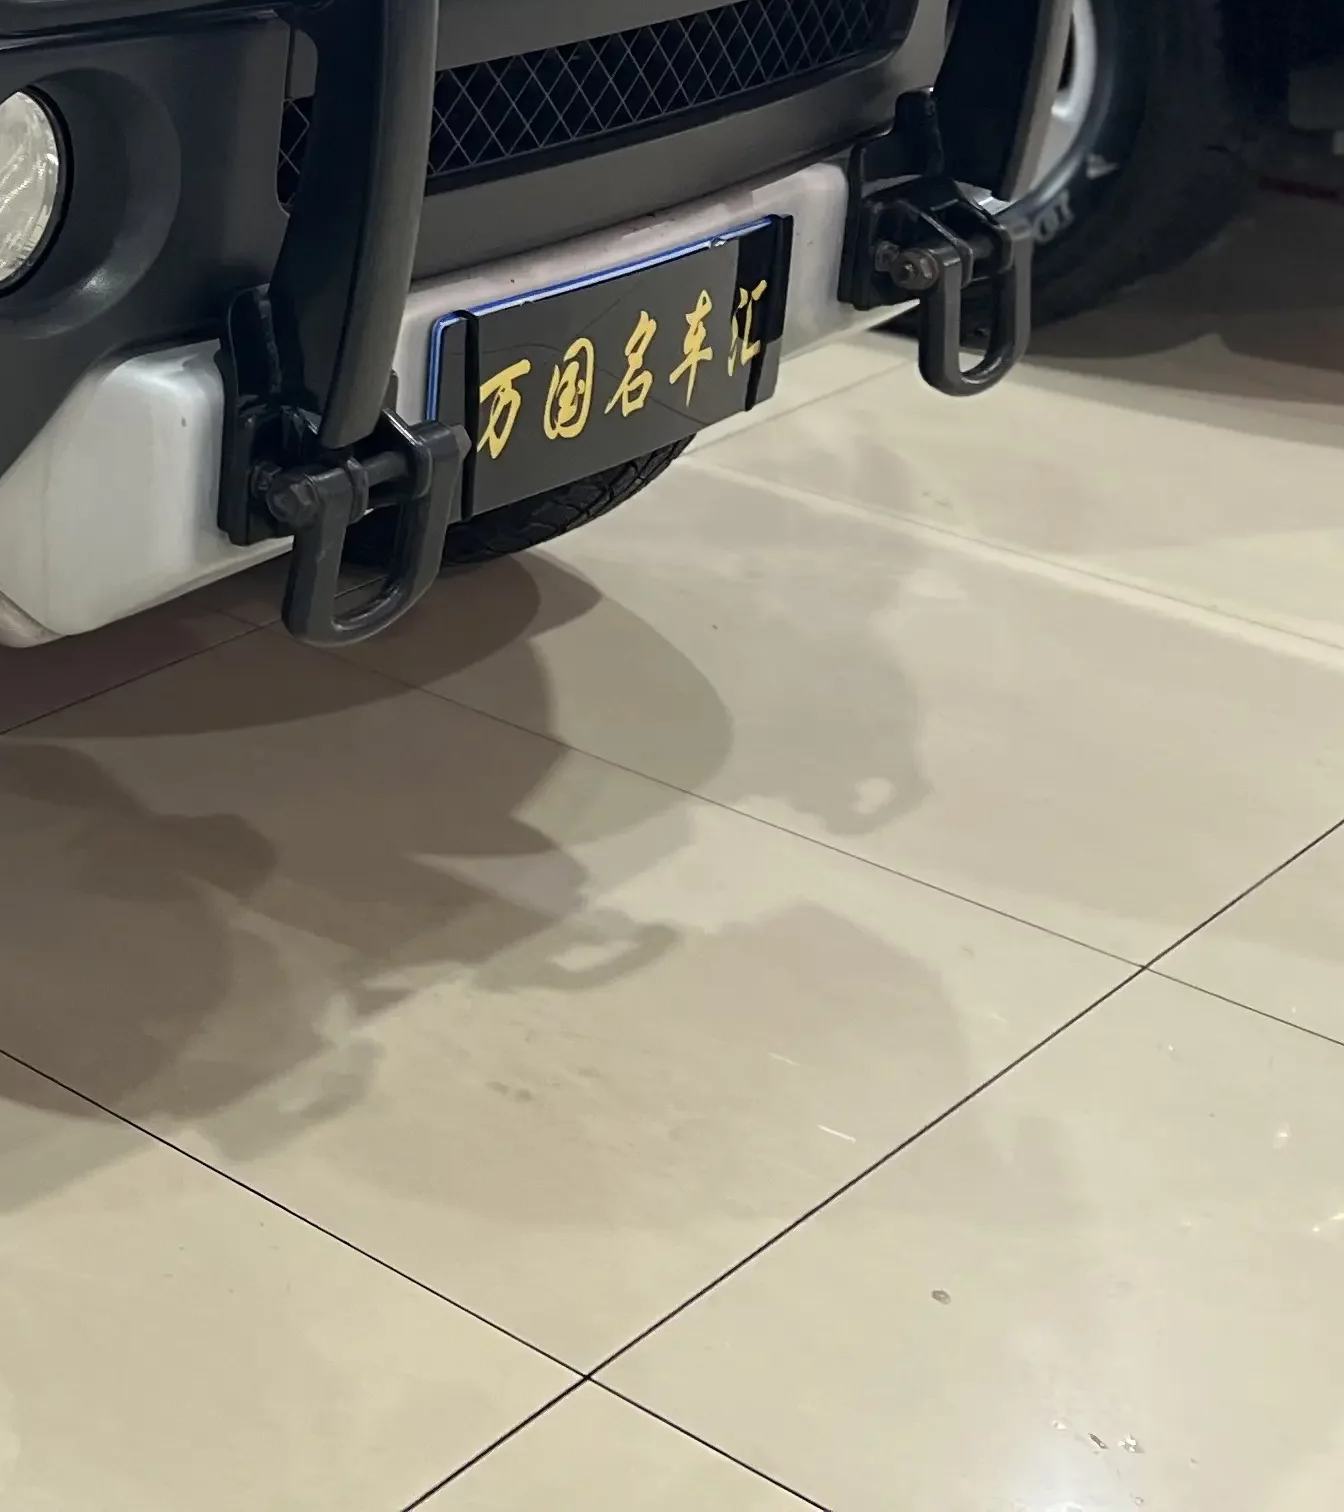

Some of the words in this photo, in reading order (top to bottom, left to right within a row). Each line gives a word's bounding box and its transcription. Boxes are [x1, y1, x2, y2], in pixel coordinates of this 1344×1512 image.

[476, 279, 768, 459] 万国名车汇
